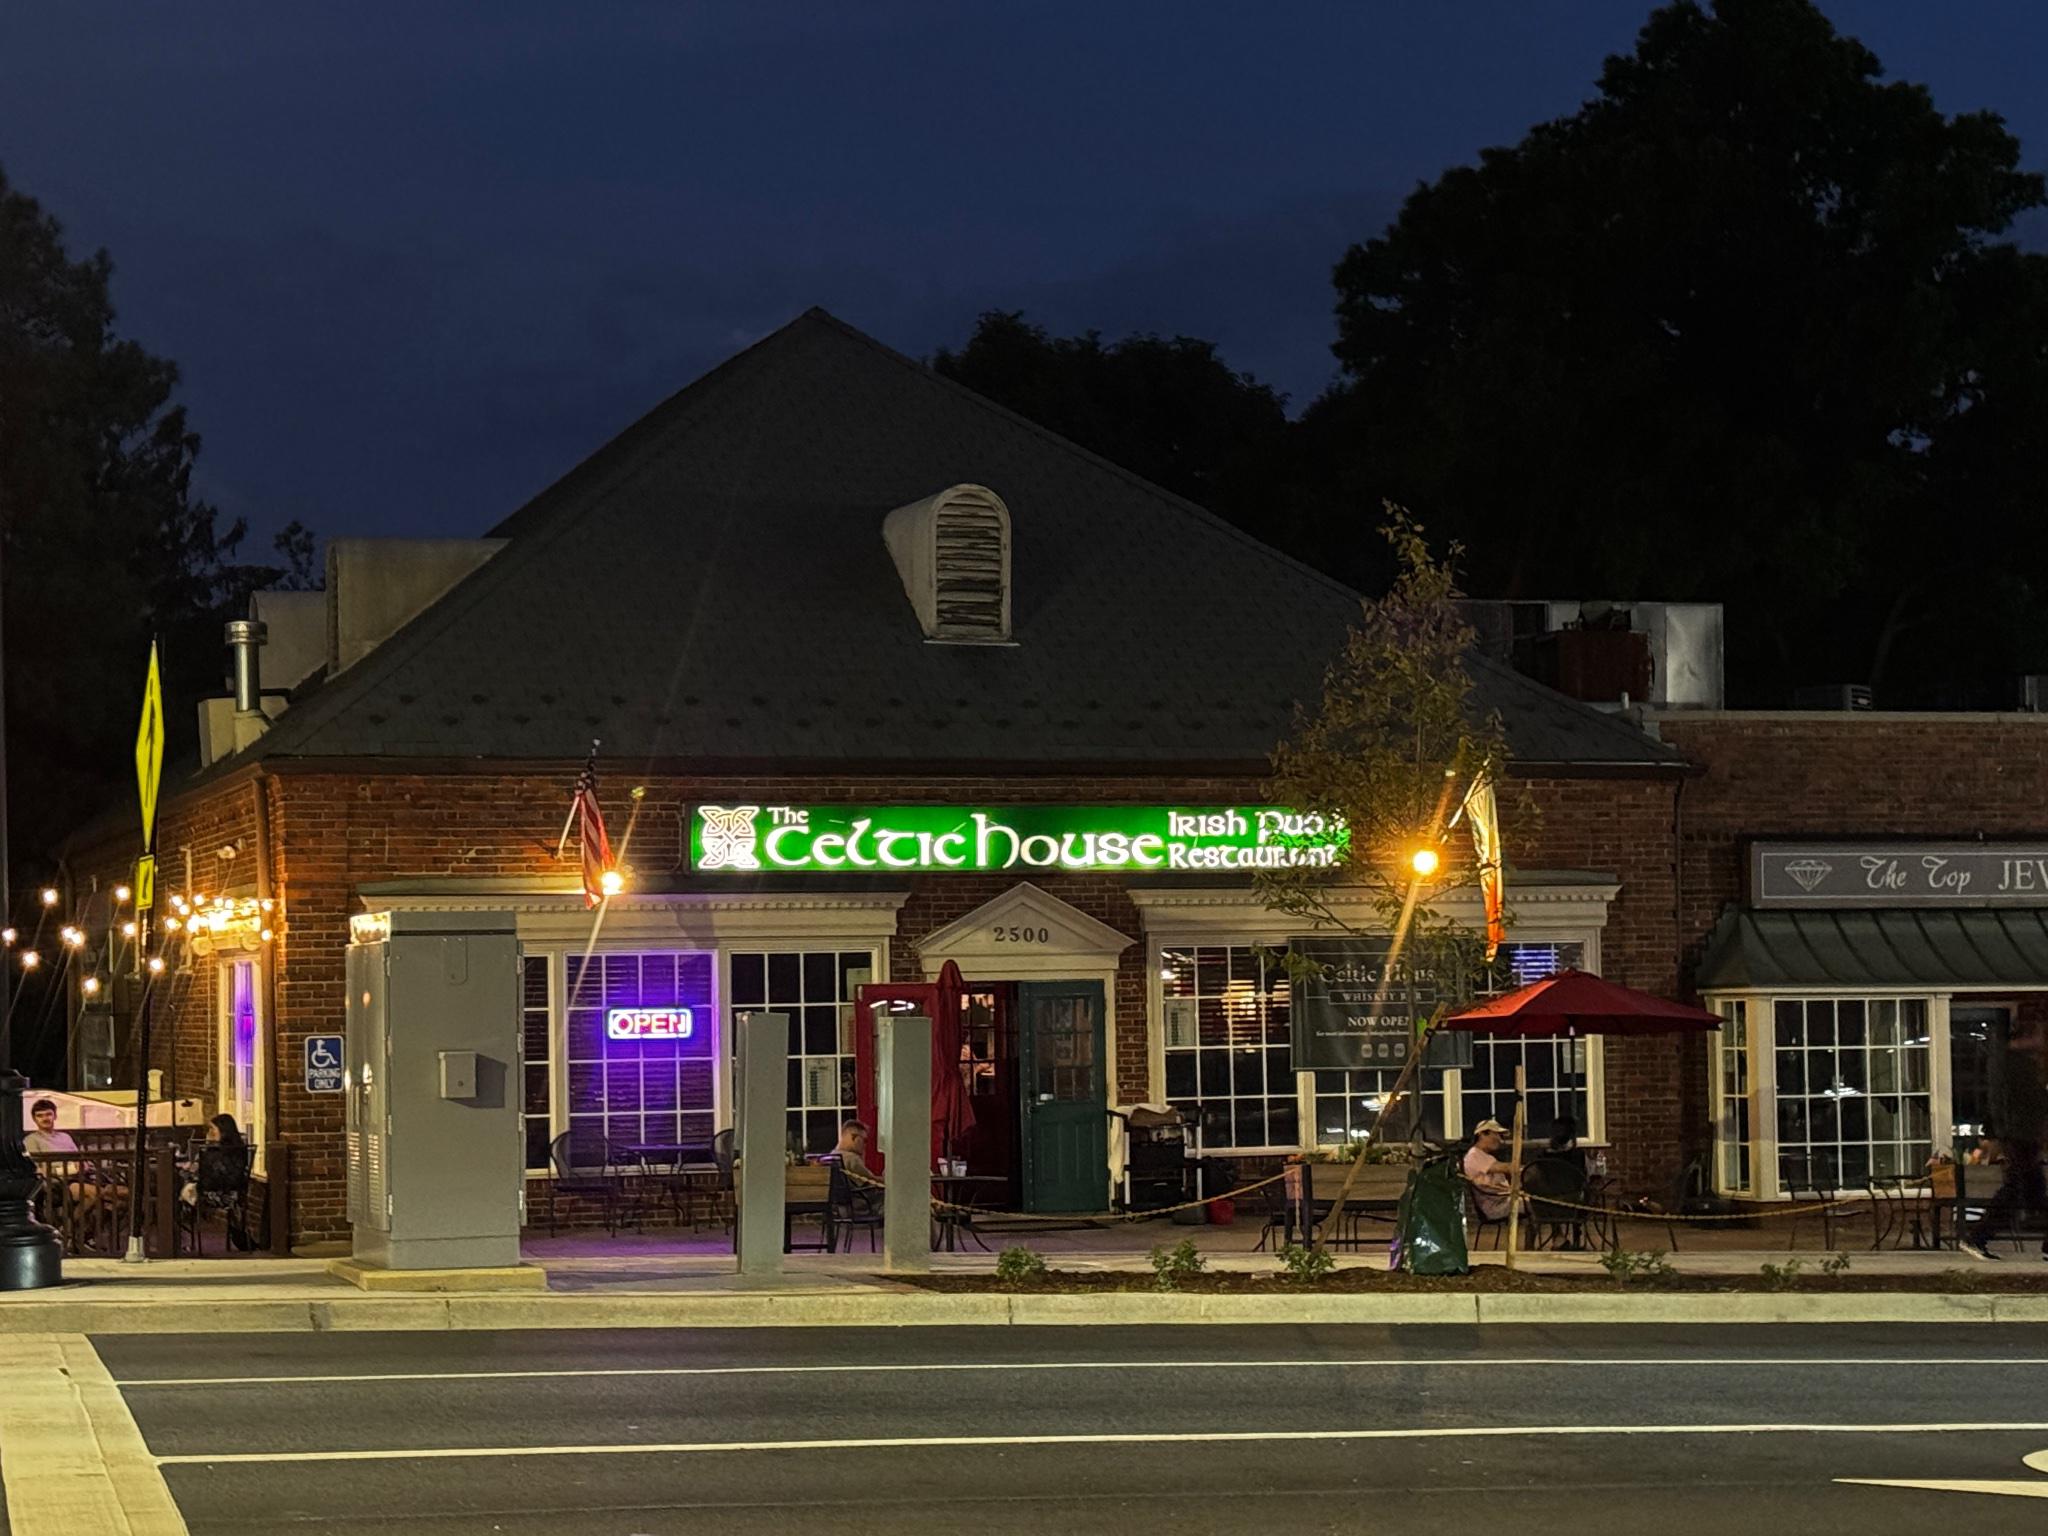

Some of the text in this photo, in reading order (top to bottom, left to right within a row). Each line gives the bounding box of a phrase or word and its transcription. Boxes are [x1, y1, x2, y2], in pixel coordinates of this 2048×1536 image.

[766, 806, 810, 825] The
[1168, 809, 1248, 837] Irish
[765, 818, 967, 867] Celtic
[1860, 855, 1907, 889] The
[1921, 855, 1971, 894] Top
[993, 926, 1049, 943] 2500
[1319, 963, 1378, 983] Celtic
[1400, 992, 1423, 1001] BR
[613, 1013, 686, 1034] OPEN
[1348, 1016, 1377, 1027] NOW
